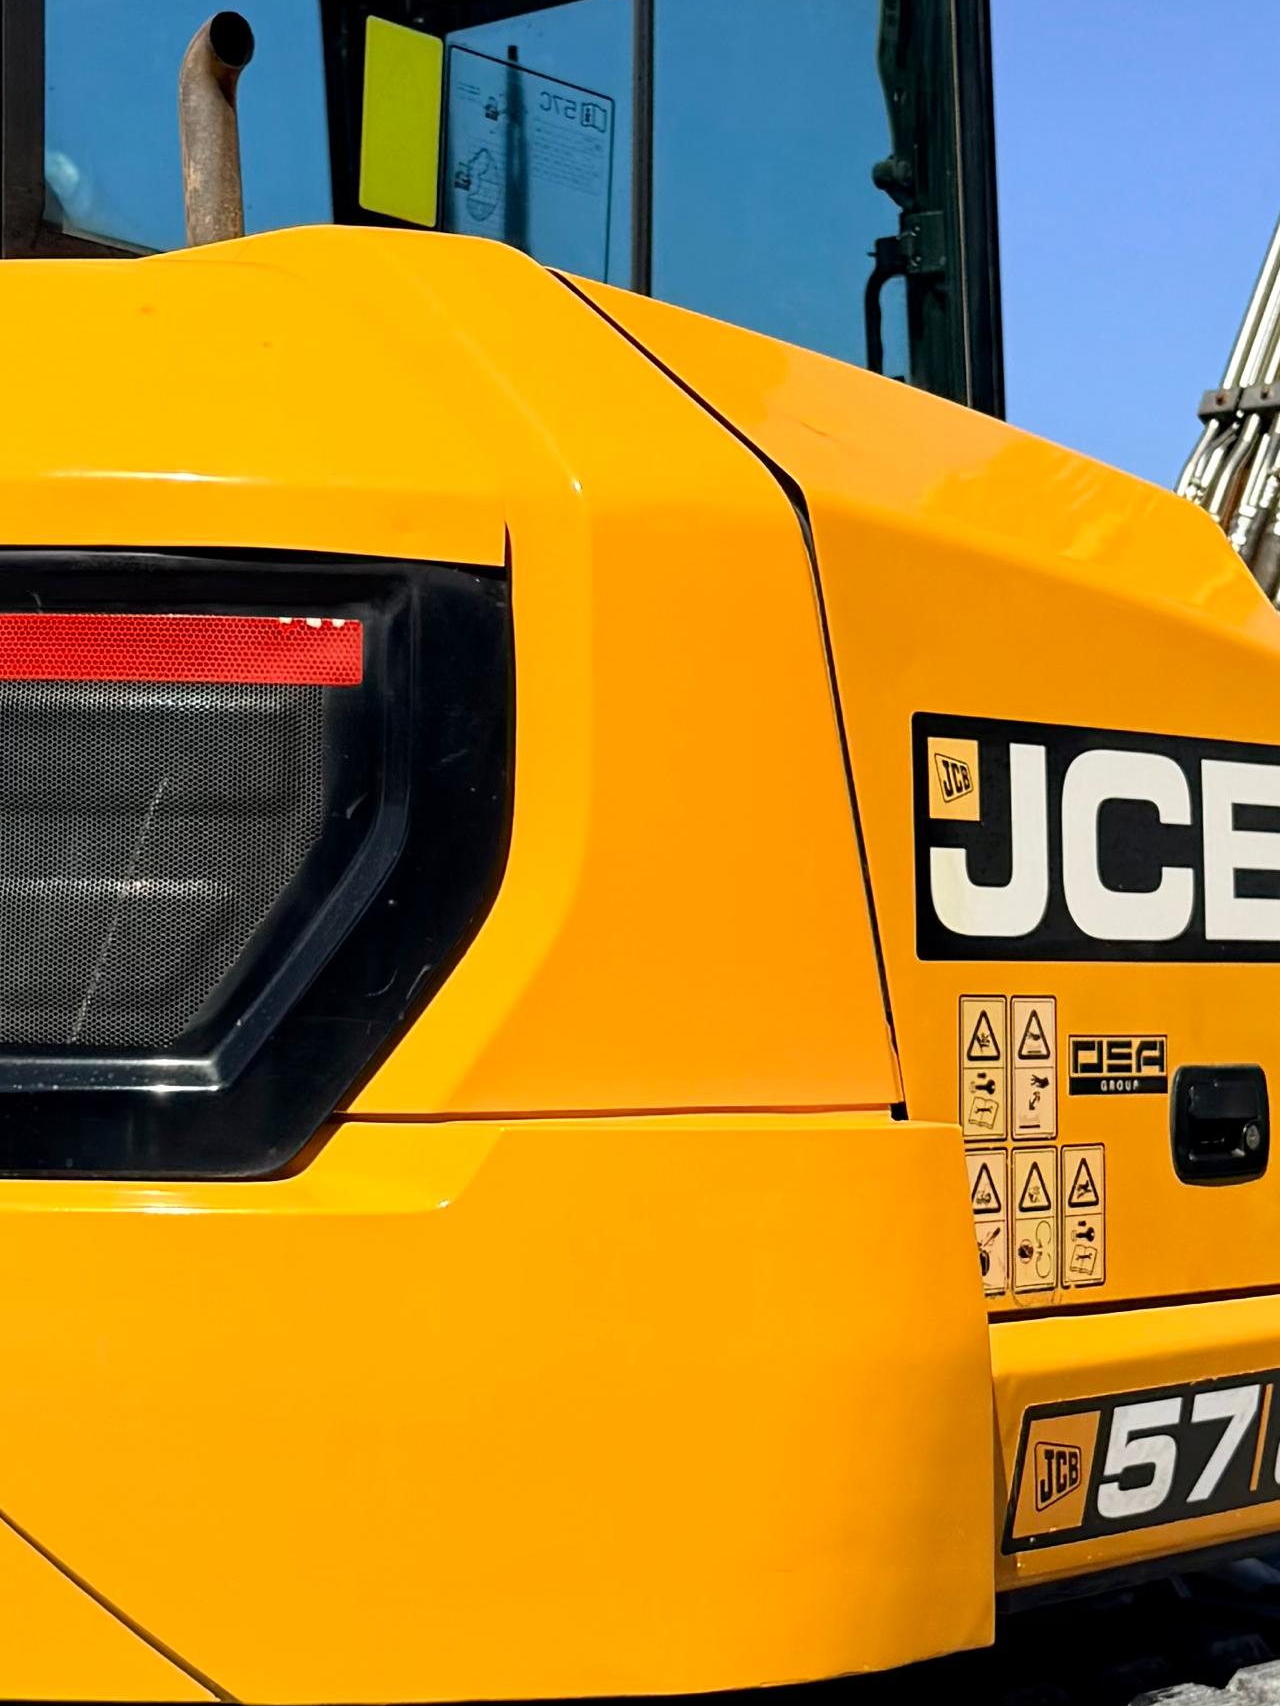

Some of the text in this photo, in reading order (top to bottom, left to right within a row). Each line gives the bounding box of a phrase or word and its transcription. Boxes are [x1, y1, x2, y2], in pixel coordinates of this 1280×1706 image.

[942, 759, 971, 798] JCB
[1100, 1079, 1140, 1092] GROUP
[1096, 1383, 1262, 1520] 57
[1039, 1448, 1079, 1504] JCB
